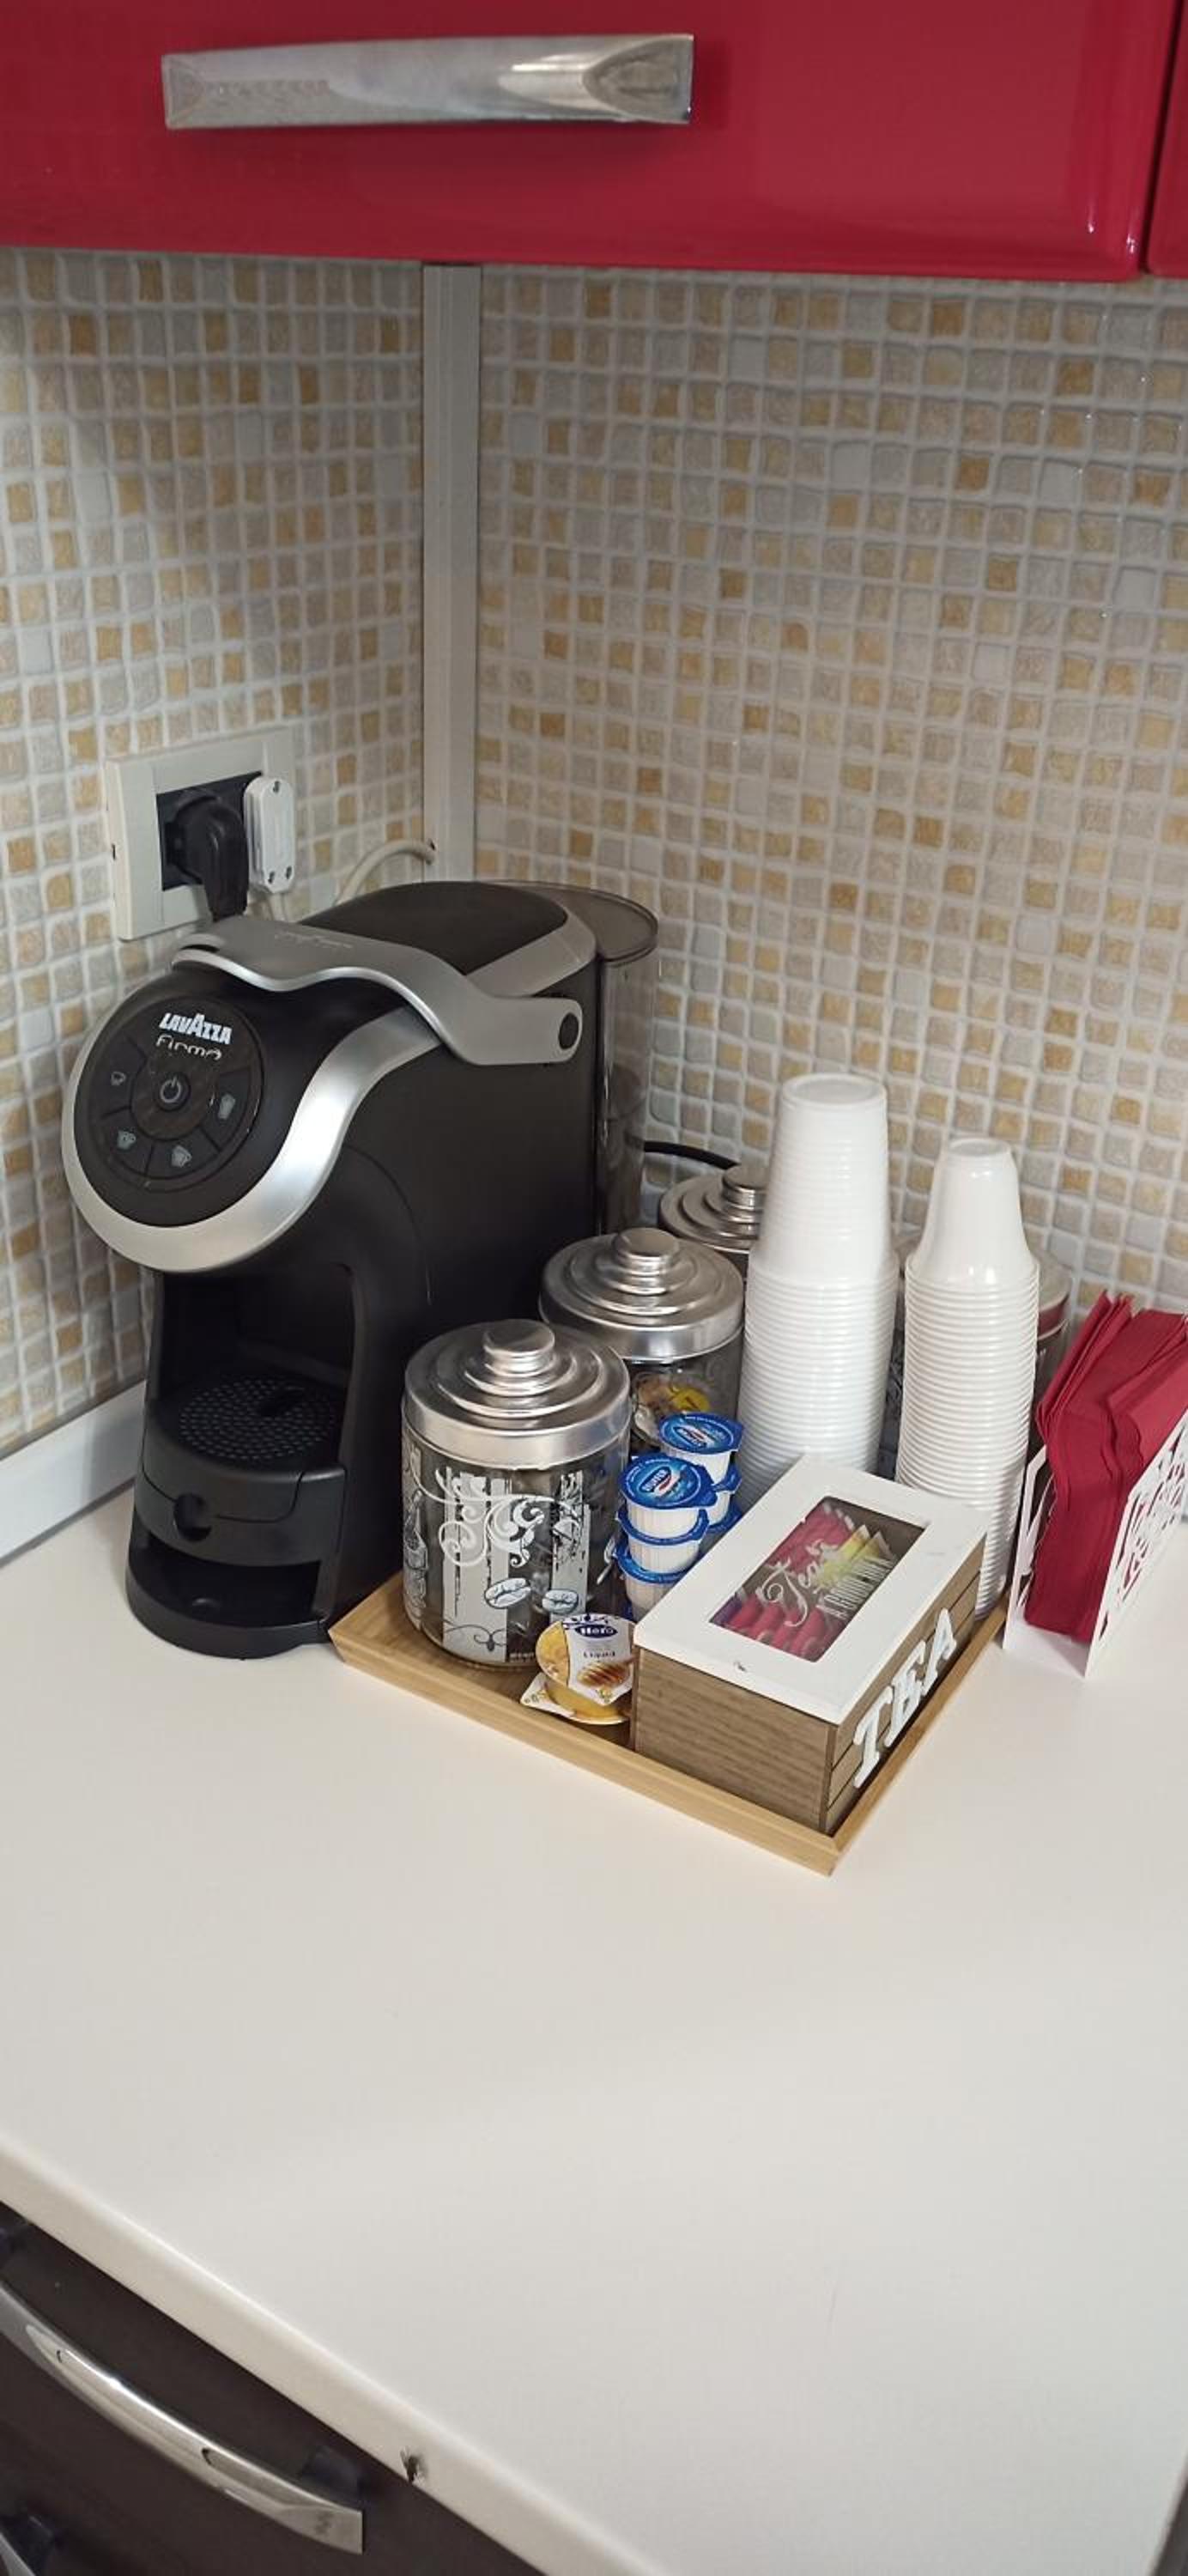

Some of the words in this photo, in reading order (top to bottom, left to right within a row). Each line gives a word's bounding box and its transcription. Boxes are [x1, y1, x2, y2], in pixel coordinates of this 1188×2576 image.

[159, 1013, 233, 1045] LAVAZZA
[579, 1626, 615, 1635] Hero
[853, 1607, 957, 1788] TEA
